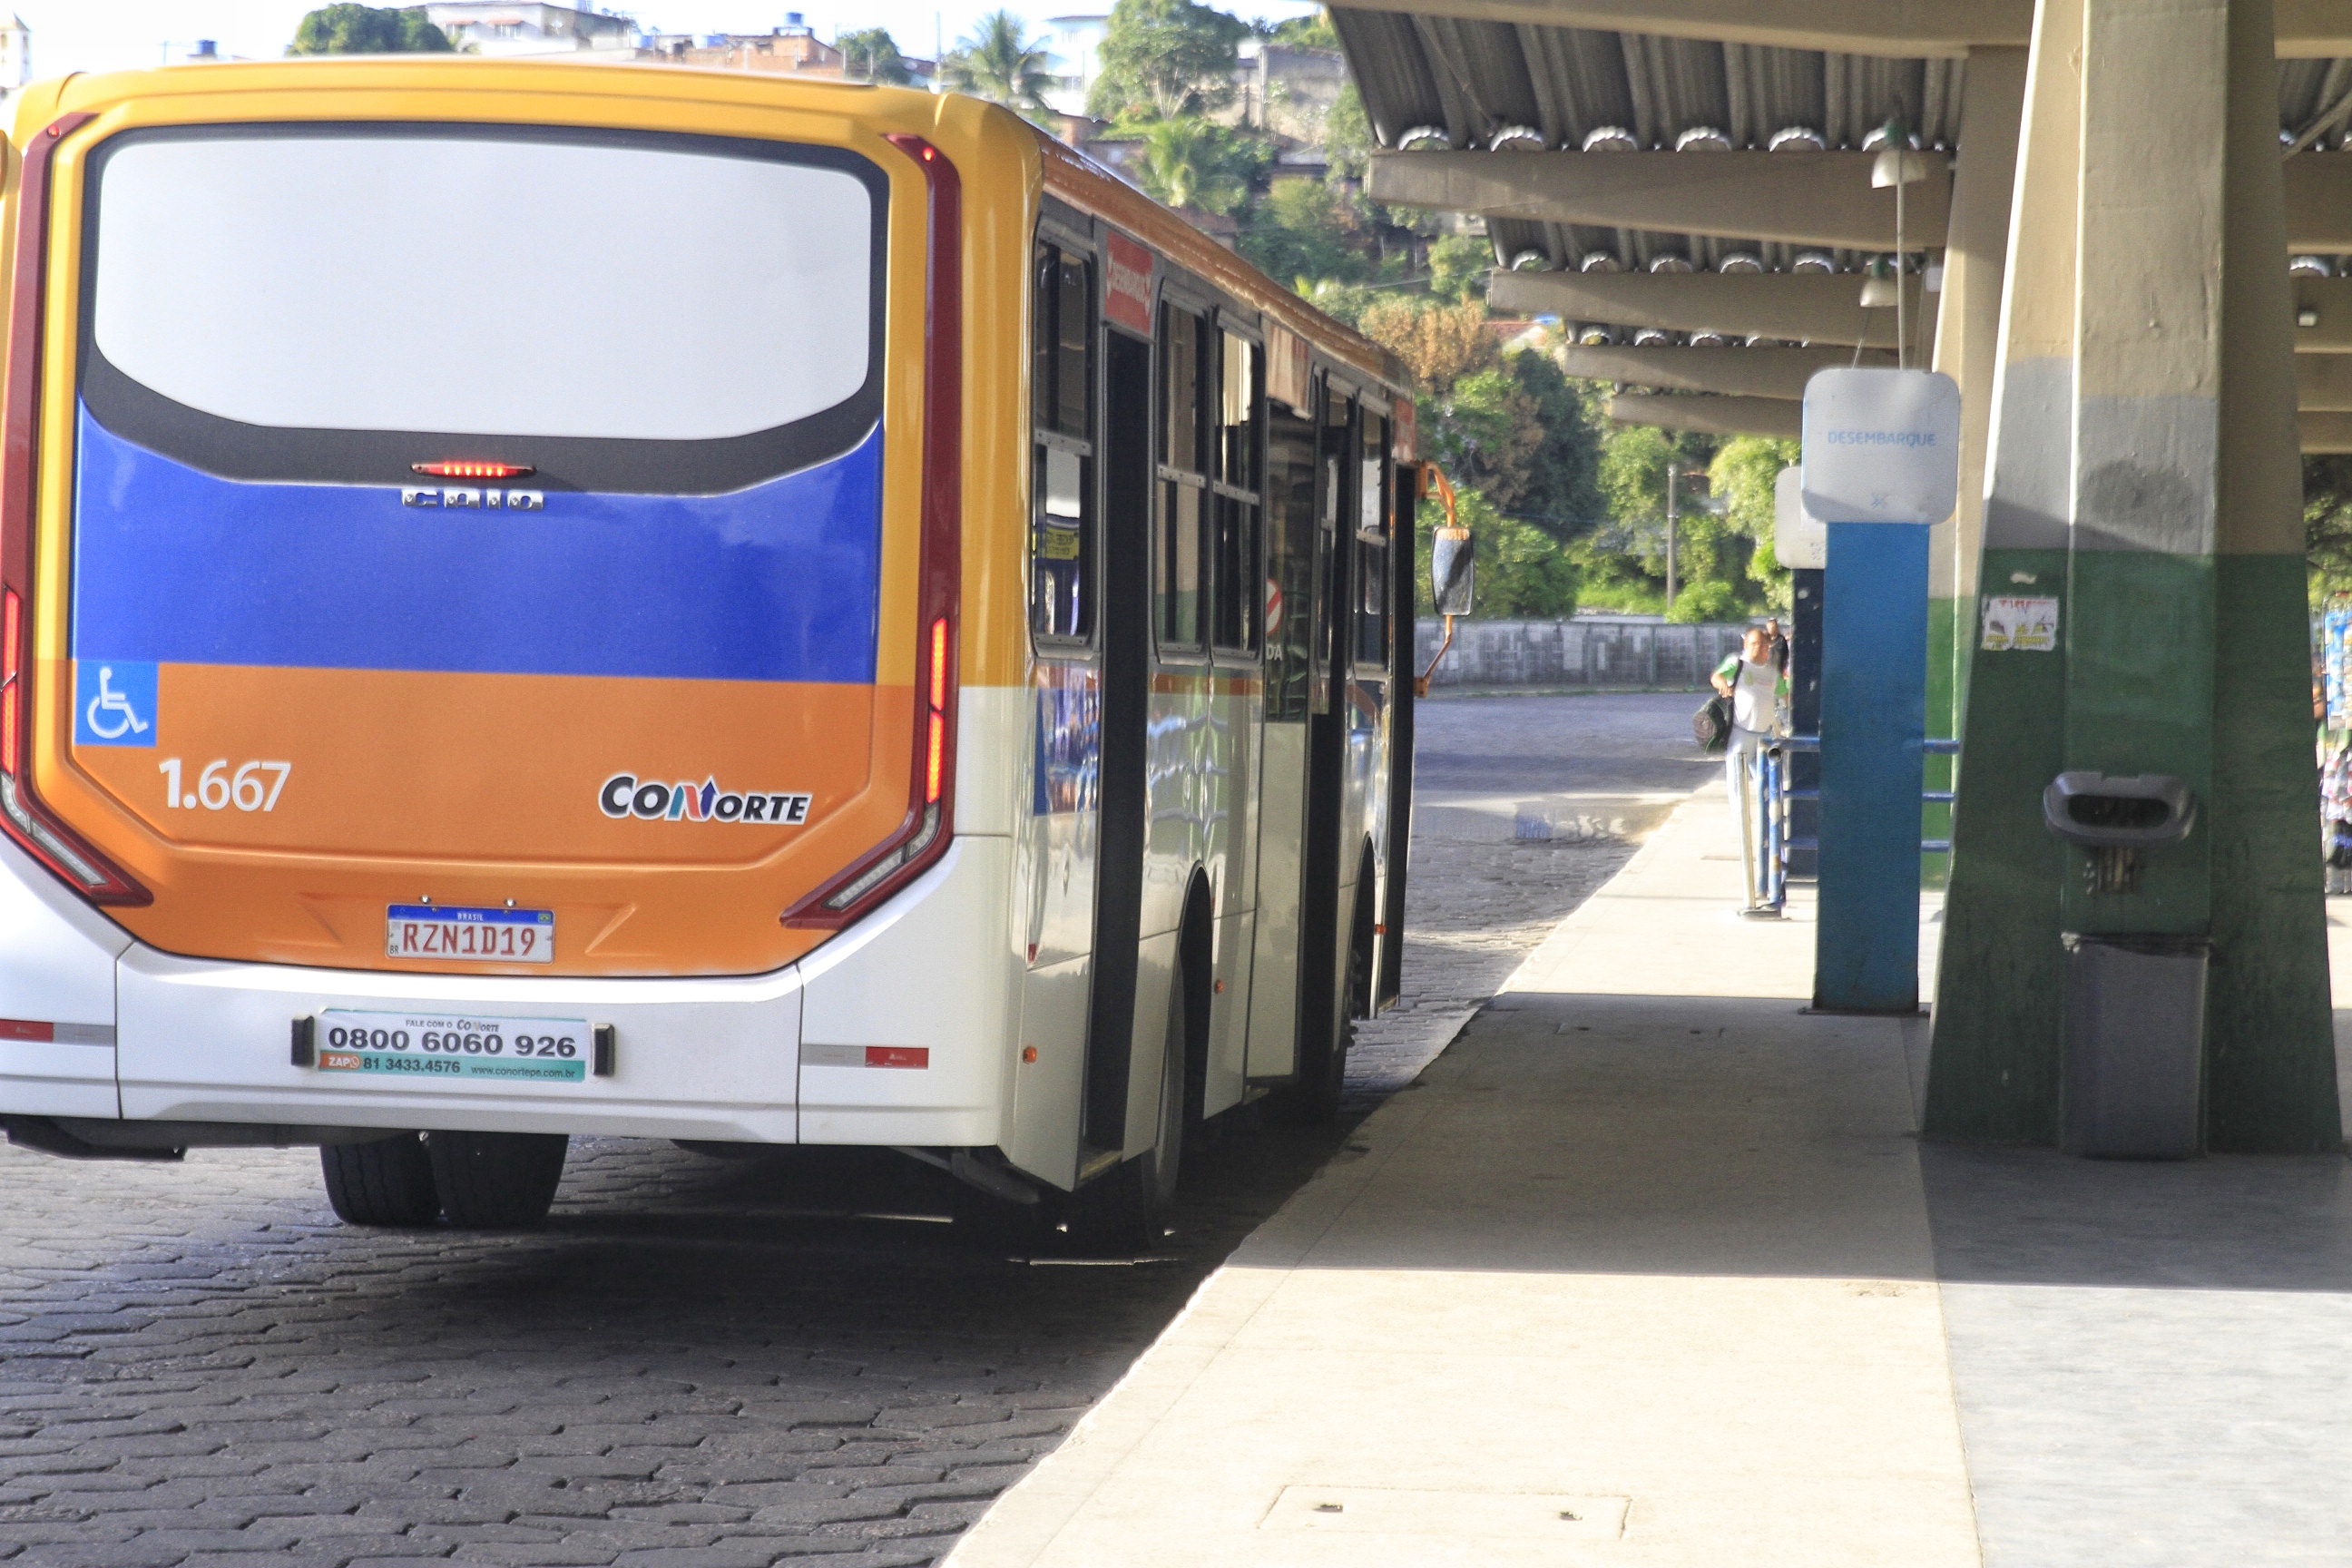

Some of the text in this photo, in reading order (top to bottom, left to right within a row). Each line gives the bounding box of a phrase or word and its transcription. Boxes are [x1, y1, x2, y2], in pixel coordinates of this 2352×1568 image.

[1828, 431, 1936, 448] DESEMBARQUE
[401, 488, 544, 510] CAIO
[159, 758, 291, 812] 1.667
[456, 912, 485, 922] BRASIL
[403, 923, 535, 956] RZN1D19
[389, 945, 399, 955] BR
[406, 1019, 426, 1028] FALE
[426, 1020, 445, 1028] COM
[328, 1027, 576, 1058] 0800 6060 926
[328, 1056, 351, 1067] ZAP
[363, 1057, 461, 1073] 81 3433.4576
